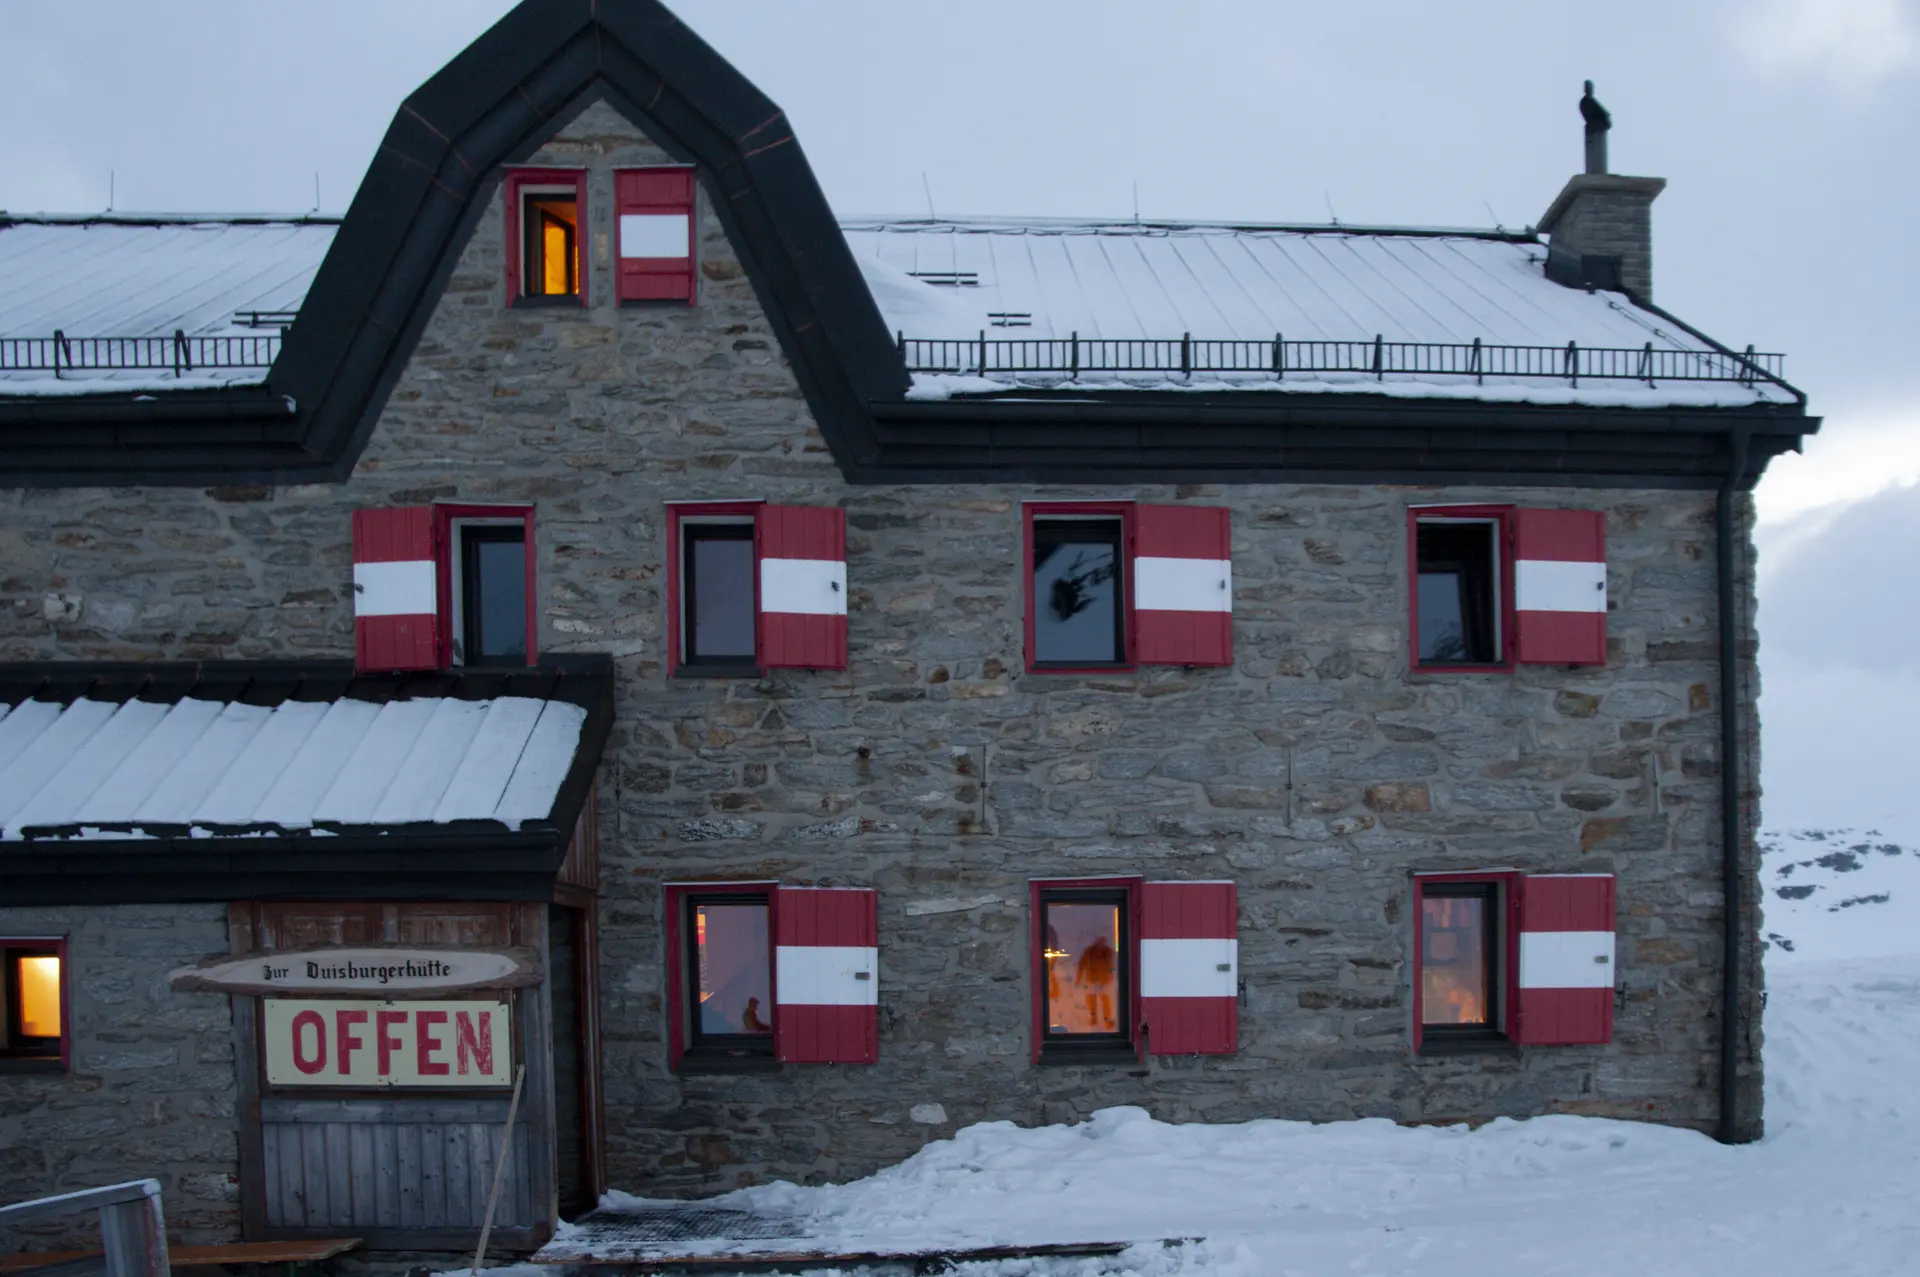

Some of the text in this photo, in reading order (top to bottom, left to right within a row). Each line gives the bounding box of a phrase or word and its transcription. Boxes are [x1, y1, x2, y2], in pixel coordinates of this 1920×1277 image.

[263, 960, 451, 984] Zur Duisburgerhütte
[291, 1009, 494, 1076] OFFEN
